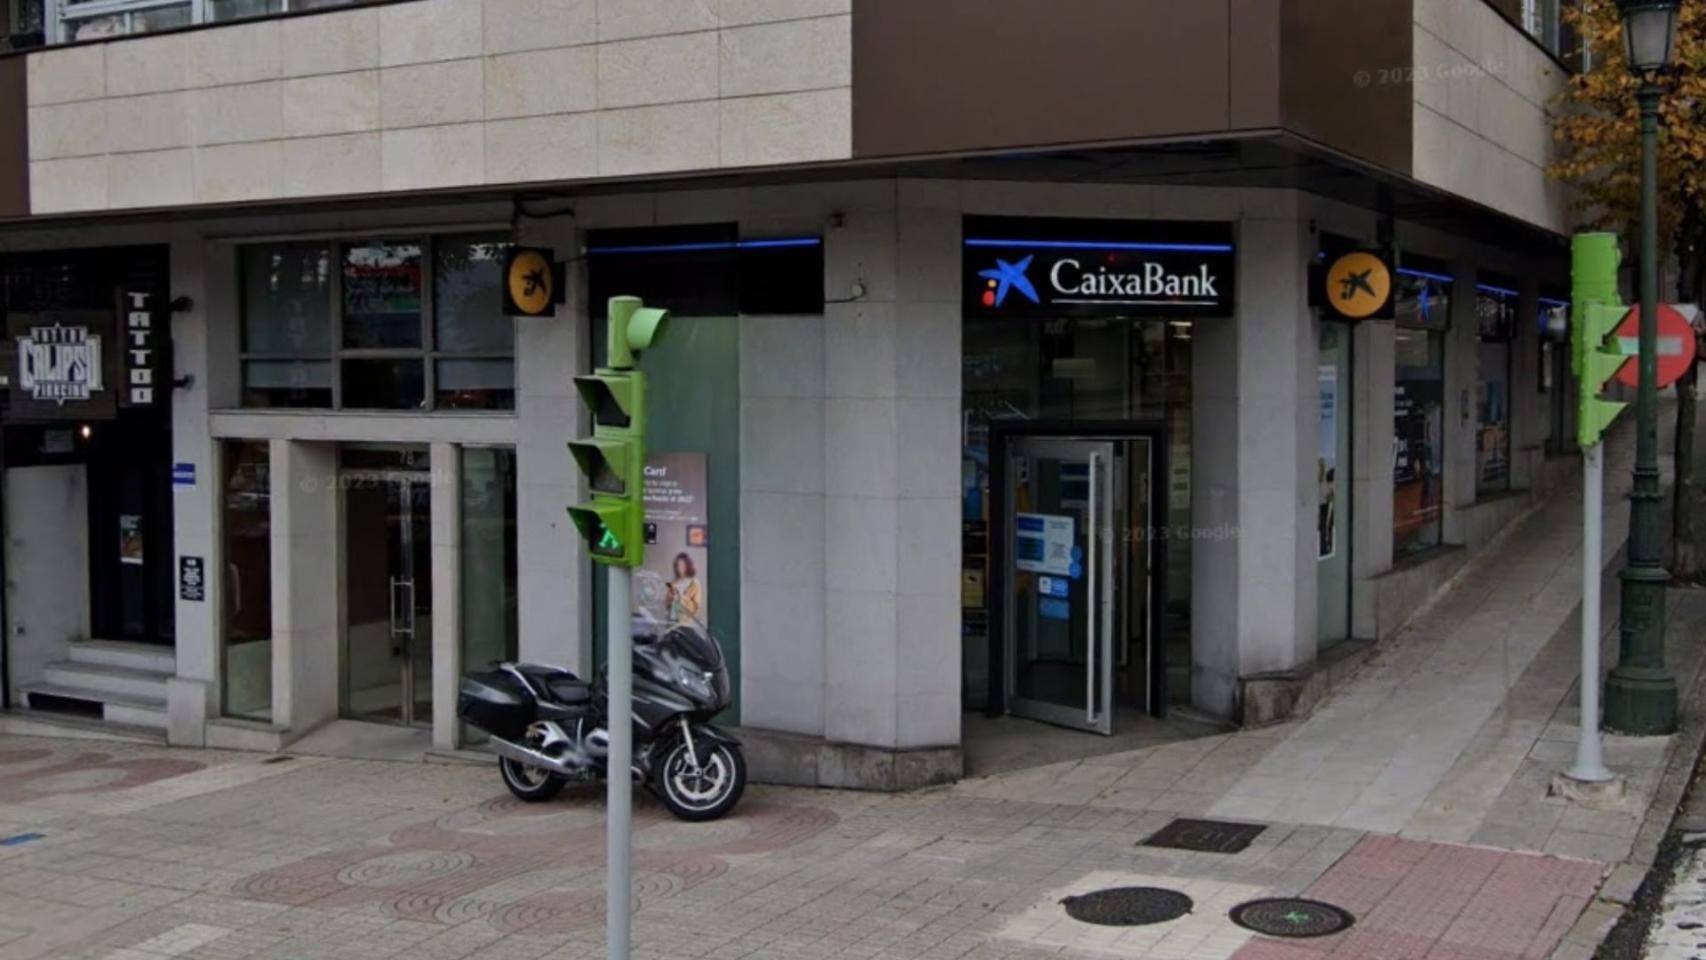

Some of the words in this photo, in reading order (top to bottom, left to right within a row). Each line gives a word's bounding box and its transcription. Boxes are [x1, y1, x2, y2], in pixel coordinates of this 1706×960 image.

[1050, 258, 1218, 297] CaixaBank
[18, 336, 101, 389] CALIPSO
[128, 292, 152, 403] TATTOO
